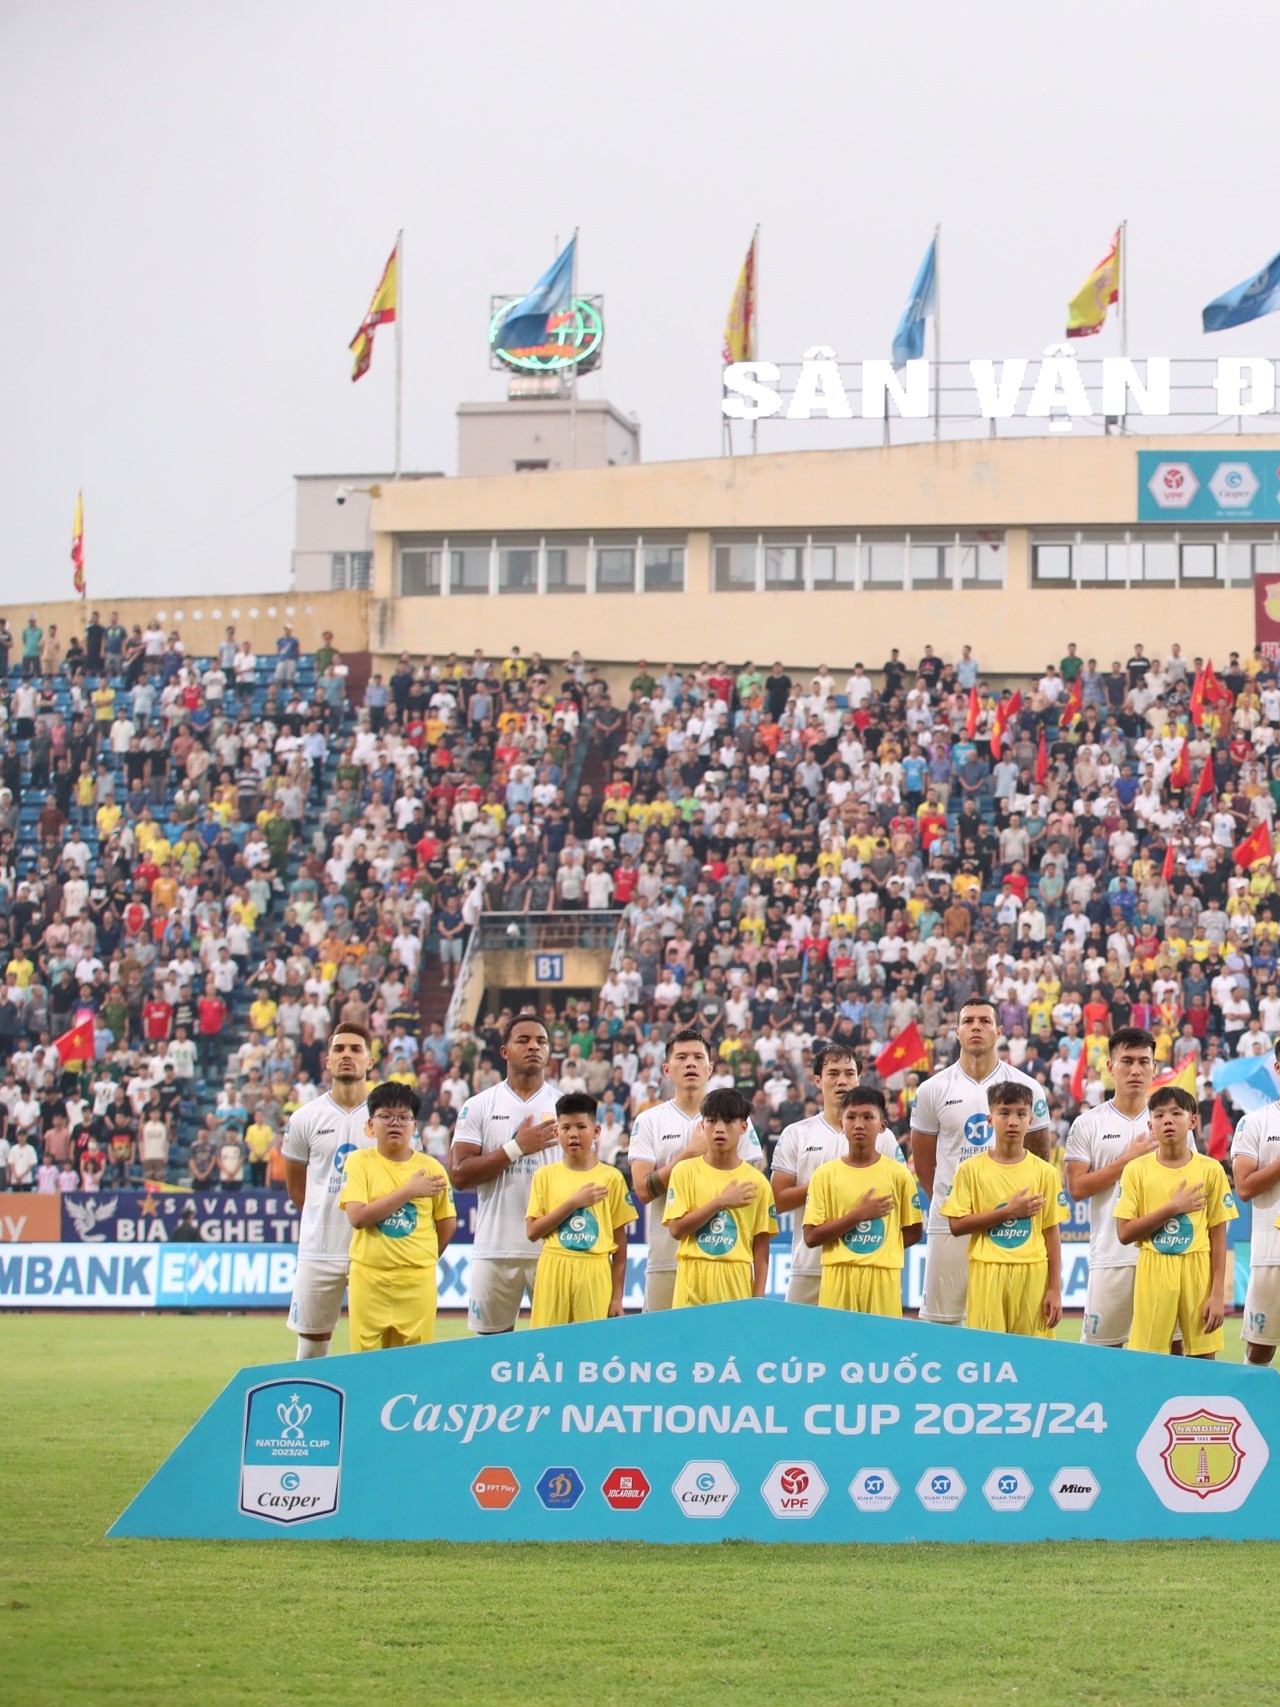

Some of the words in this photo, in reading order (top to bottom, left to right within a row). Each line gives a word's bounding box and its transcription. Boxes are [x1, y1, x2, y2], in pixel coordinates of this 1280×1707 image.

[722, 345, 931, 419] SÂN
[969, 342, 1171, 432] VẬN
[1218, 488, 1250, 501] Casper
[537, 956, 562, 979] B1
[117, 1218, 168, 1242] BIA
[178, 1218, 264, 1242] GHE
[382, 1218, 416, 1229] asper
[559, 1230, 596, 1244] Casper
[697, 1232, 734, 1246] Casper
[844, 1231, 882, 1244] Casper
[989, 1226, 1029, 1239] Casper
[1153, 1233, 1191, 1246] Casper
[491, 1352, 563, 1383] GIẢI
[578, 1355, 678, 1383] BÓNG
[692, 1356, 742, 1383] ĐÁ
[756, 1355, 827, 1384] CÚP
[840, 1352, 942, 1384] QUỐC
[957, 1361, 1019, 1383] GIA
[380, 1393, 551, 1443] Casper
[561, 1404, 788, 1433] NATIONAL
[804, 1403, 900, 1434] CUP
[914, 1402, 1108, 1437] 2023/24
[1177, 1425, 1228, 1433] NAMDINH
[255, 1439, 307, 1448] NATIONAL
[309, 1439, 330, 1448] CUP
[271, 1448, 309, 1456] 2023/24
[486, 1484, 500, 1492] FPT
[501, 1484, 516, 1492] Play
[866, 1479, 883, 1491] XT
[932, 1479, 950, 1491] XT
[1000, 1479, 1016, 1491] XT
[1058, 1484, 1092, 1494] Mitre
[607, 1489, 645, 1498] JOGARBOLA
[681, 1491, 729, 1505] Casper
[257, 1492, 320, 1511] Casper
[780, 1498, 809, 1508] VPF
